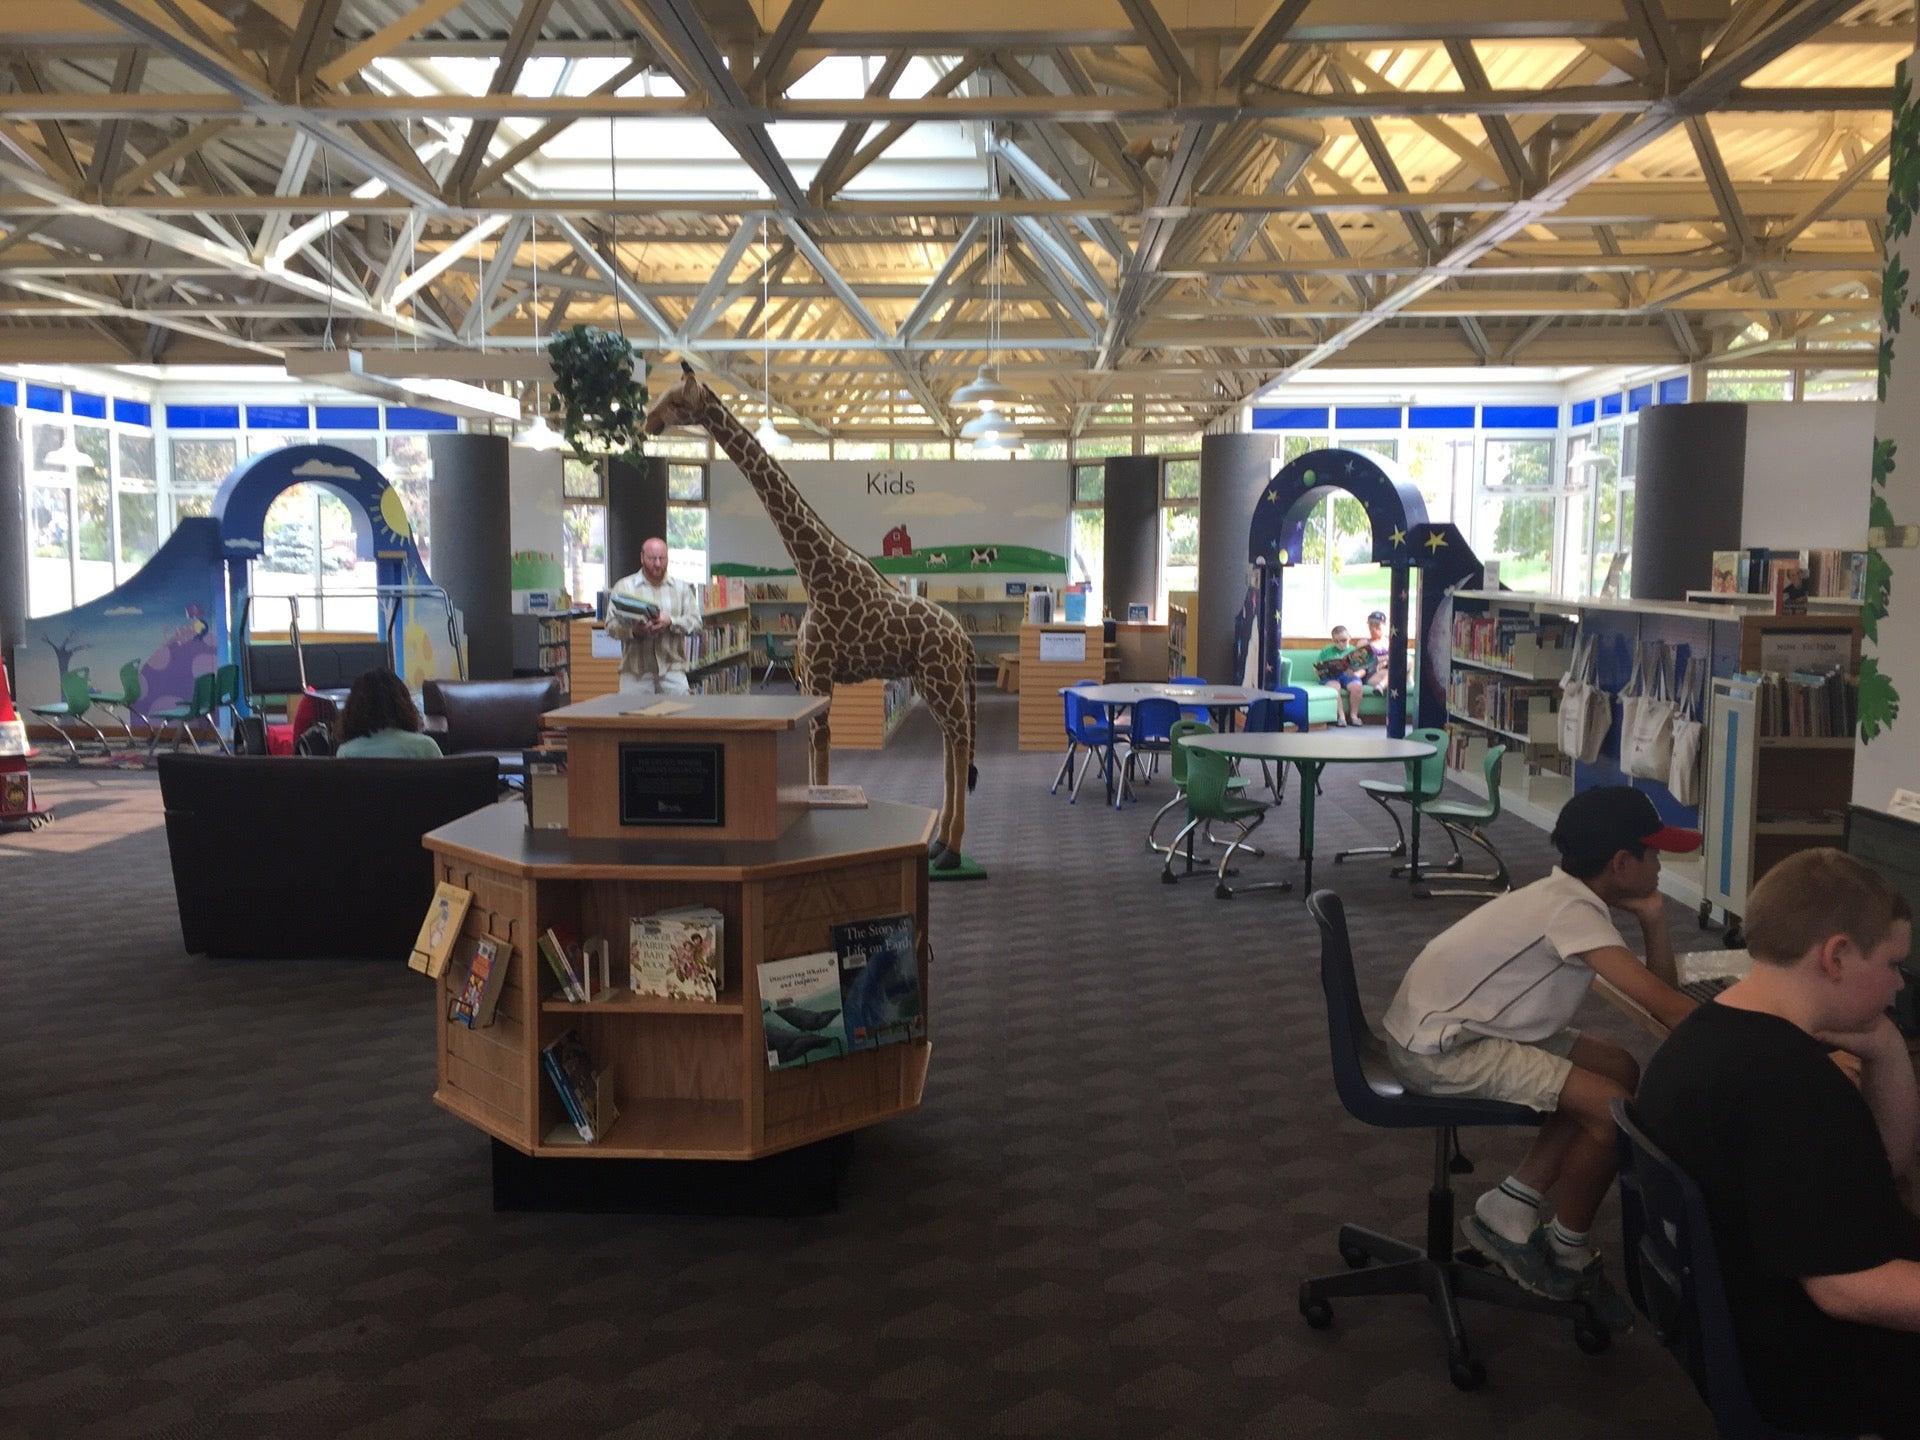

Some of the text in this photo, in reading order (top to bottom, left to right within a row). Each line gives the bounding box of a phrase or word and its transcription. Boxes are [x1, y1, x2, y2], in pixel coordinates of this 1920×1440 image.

[867, 470, 915, 496] Kids
[847, 919, 908, 939] The Story of
[643, 951, 665, 960] BABY
[847, 938, 913, 957] Life on Earth
[643, 960, 667, 969] BOOK
[769, 966, 830, 983] Discovering Whales
[780, 980, 792, 988] and
